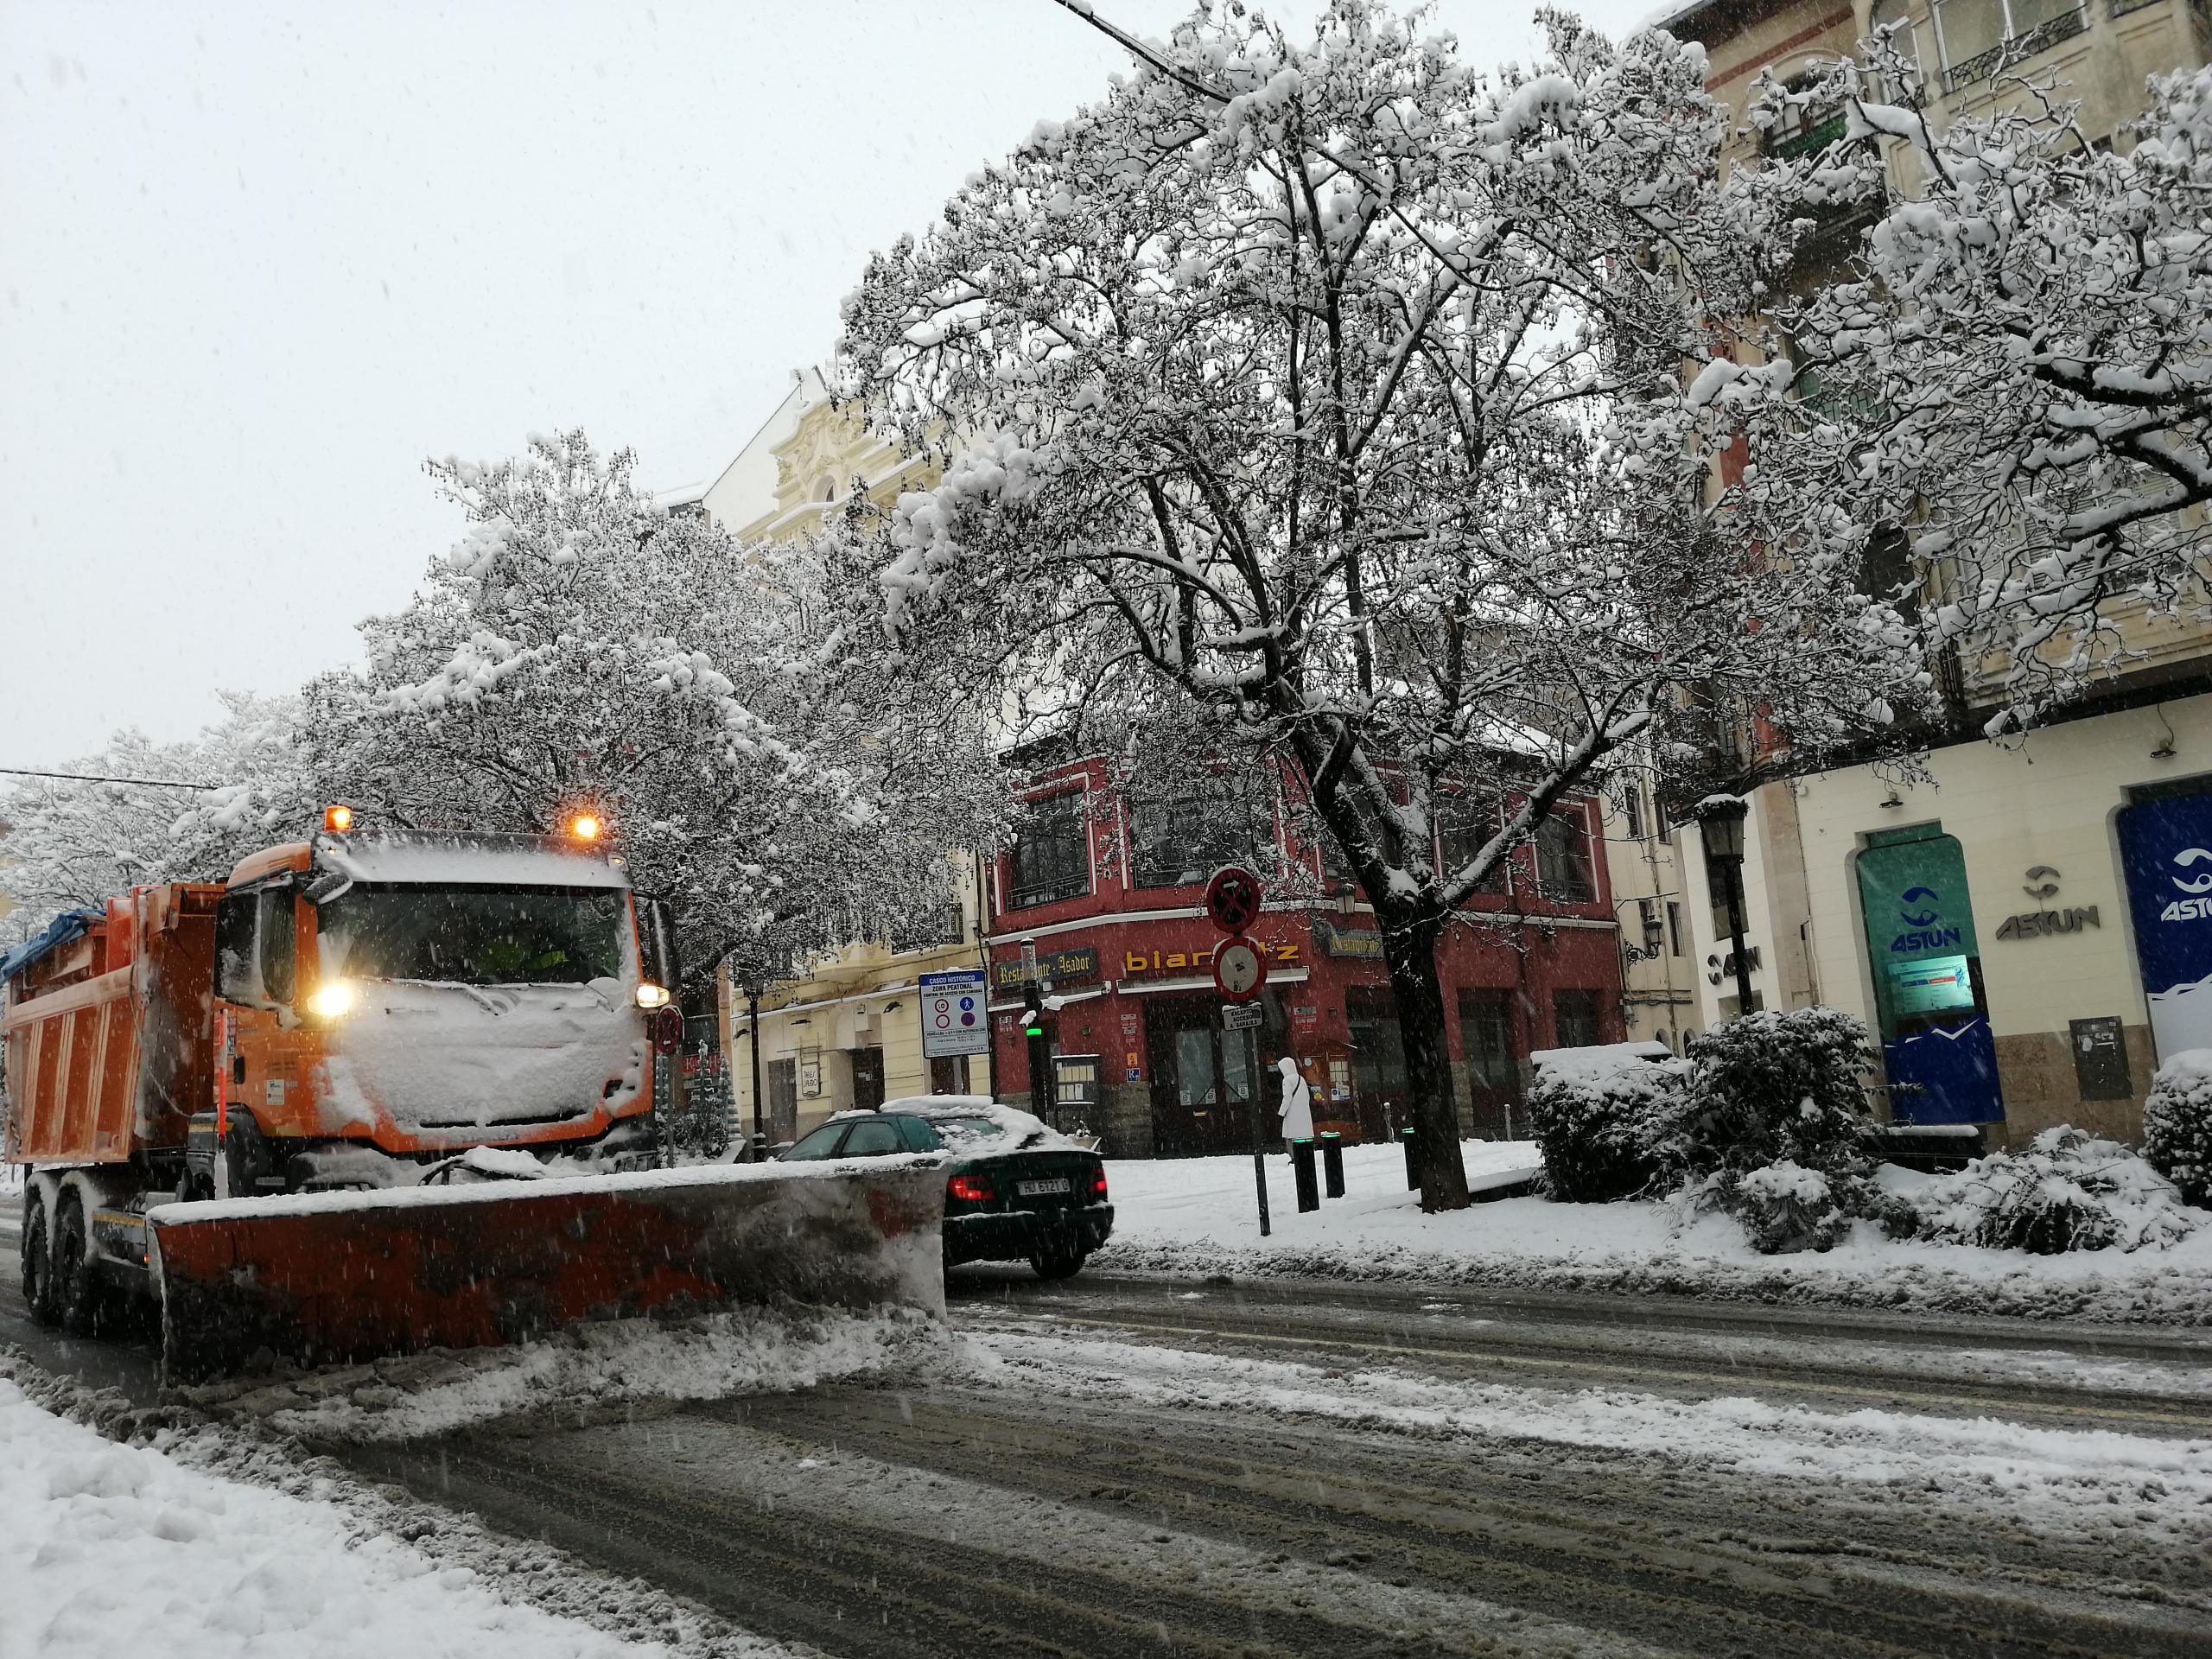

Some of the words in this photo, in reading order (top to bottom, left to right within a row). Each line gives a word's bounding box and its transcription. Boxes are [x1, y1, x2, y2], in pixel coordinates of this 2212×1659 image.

[2160, 897, 2212, 922] AST
[1995, 905, 2101, 940] ASTUN
[1891, 927, 1961, 952] ASTUN
[1126, 941, 1300, 971] biartz
[1000, 963, 1051, 983] Restante
[1058, 955, 1090, 974] Asador
[948, 982, 973, 991] PEATONAL
[1038, 1180, 1060, 1192] 6121
